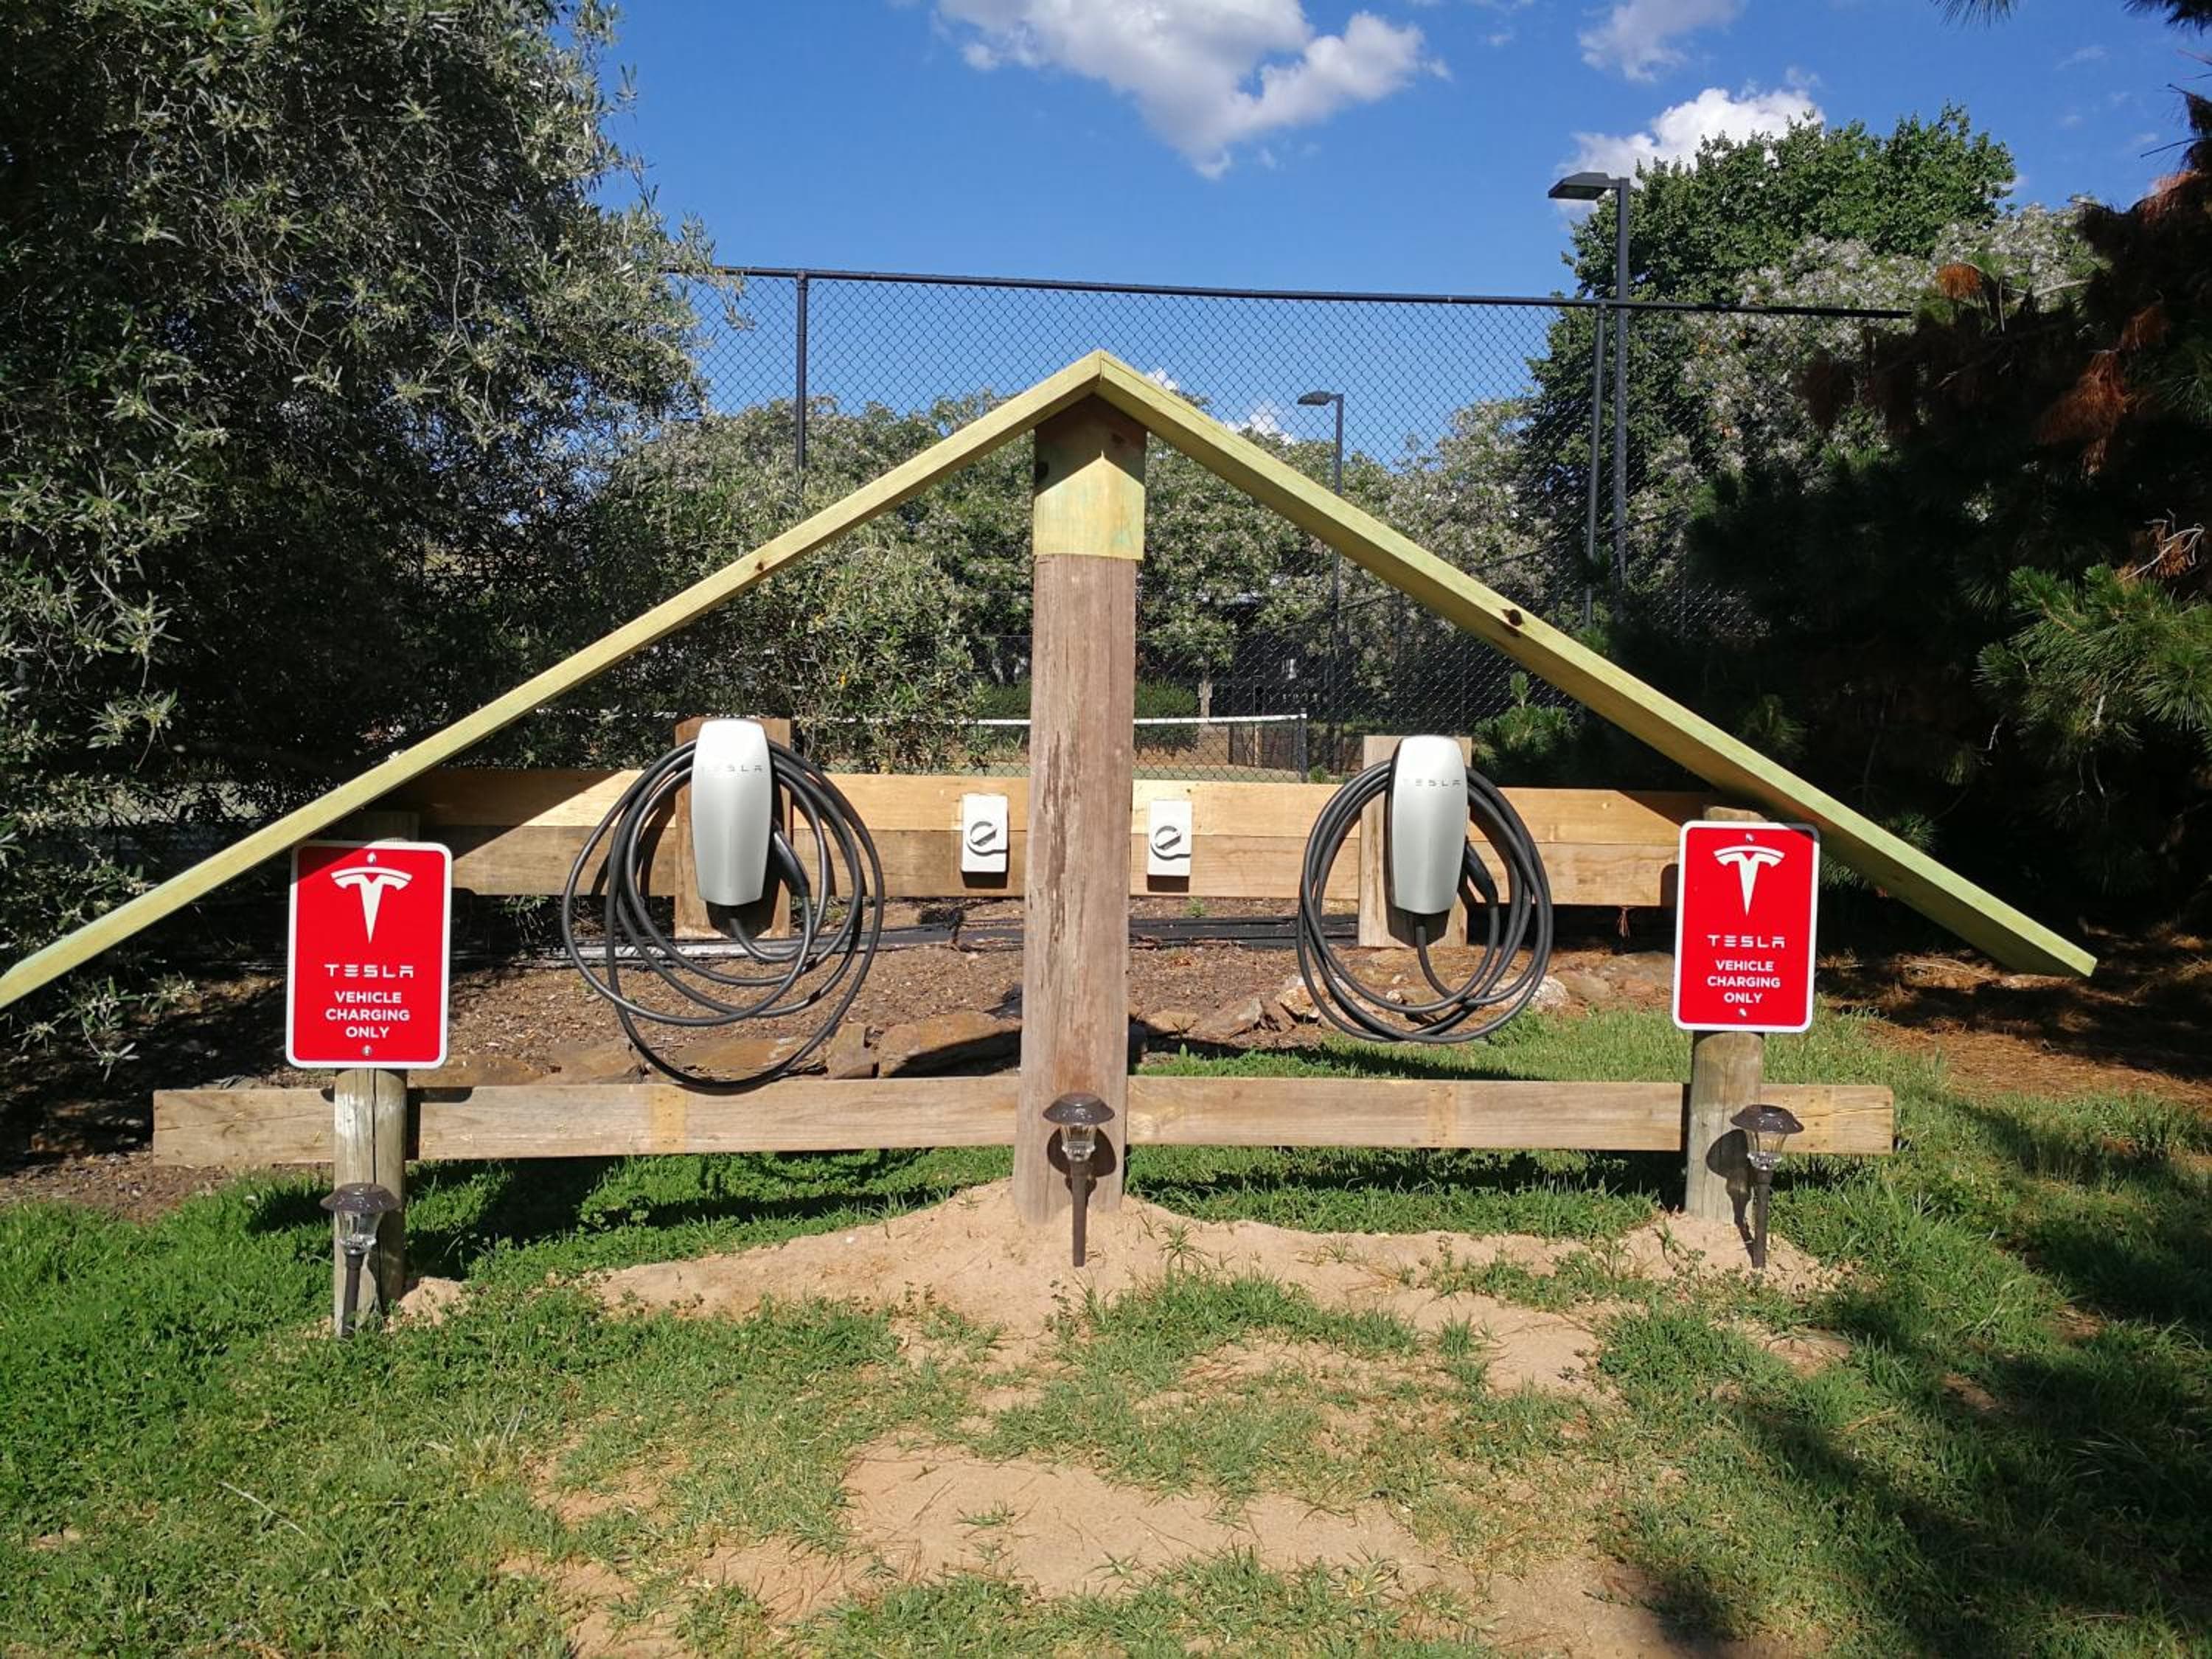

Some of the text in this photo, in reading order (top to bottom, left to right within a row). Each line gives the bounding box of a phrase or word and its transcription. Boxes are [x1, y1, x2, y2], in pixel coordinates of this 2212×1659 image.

[1402, 778, 1461, 787] ESLA
[1707, 934, 1786, 949] TESLA
[324, 964, 414, 978] TESLA
[1715, 959, 1775, 972] VEHICLE
[1707, 975, 1781, 988] CHARGING
[335, 990, 402, 1004] VEHICLE
[1723, 992, 1762, 1004] ONLY
[325, 1008, 410, 1022] CHARGING
[345, 1026, 389, 1038] ONLY
